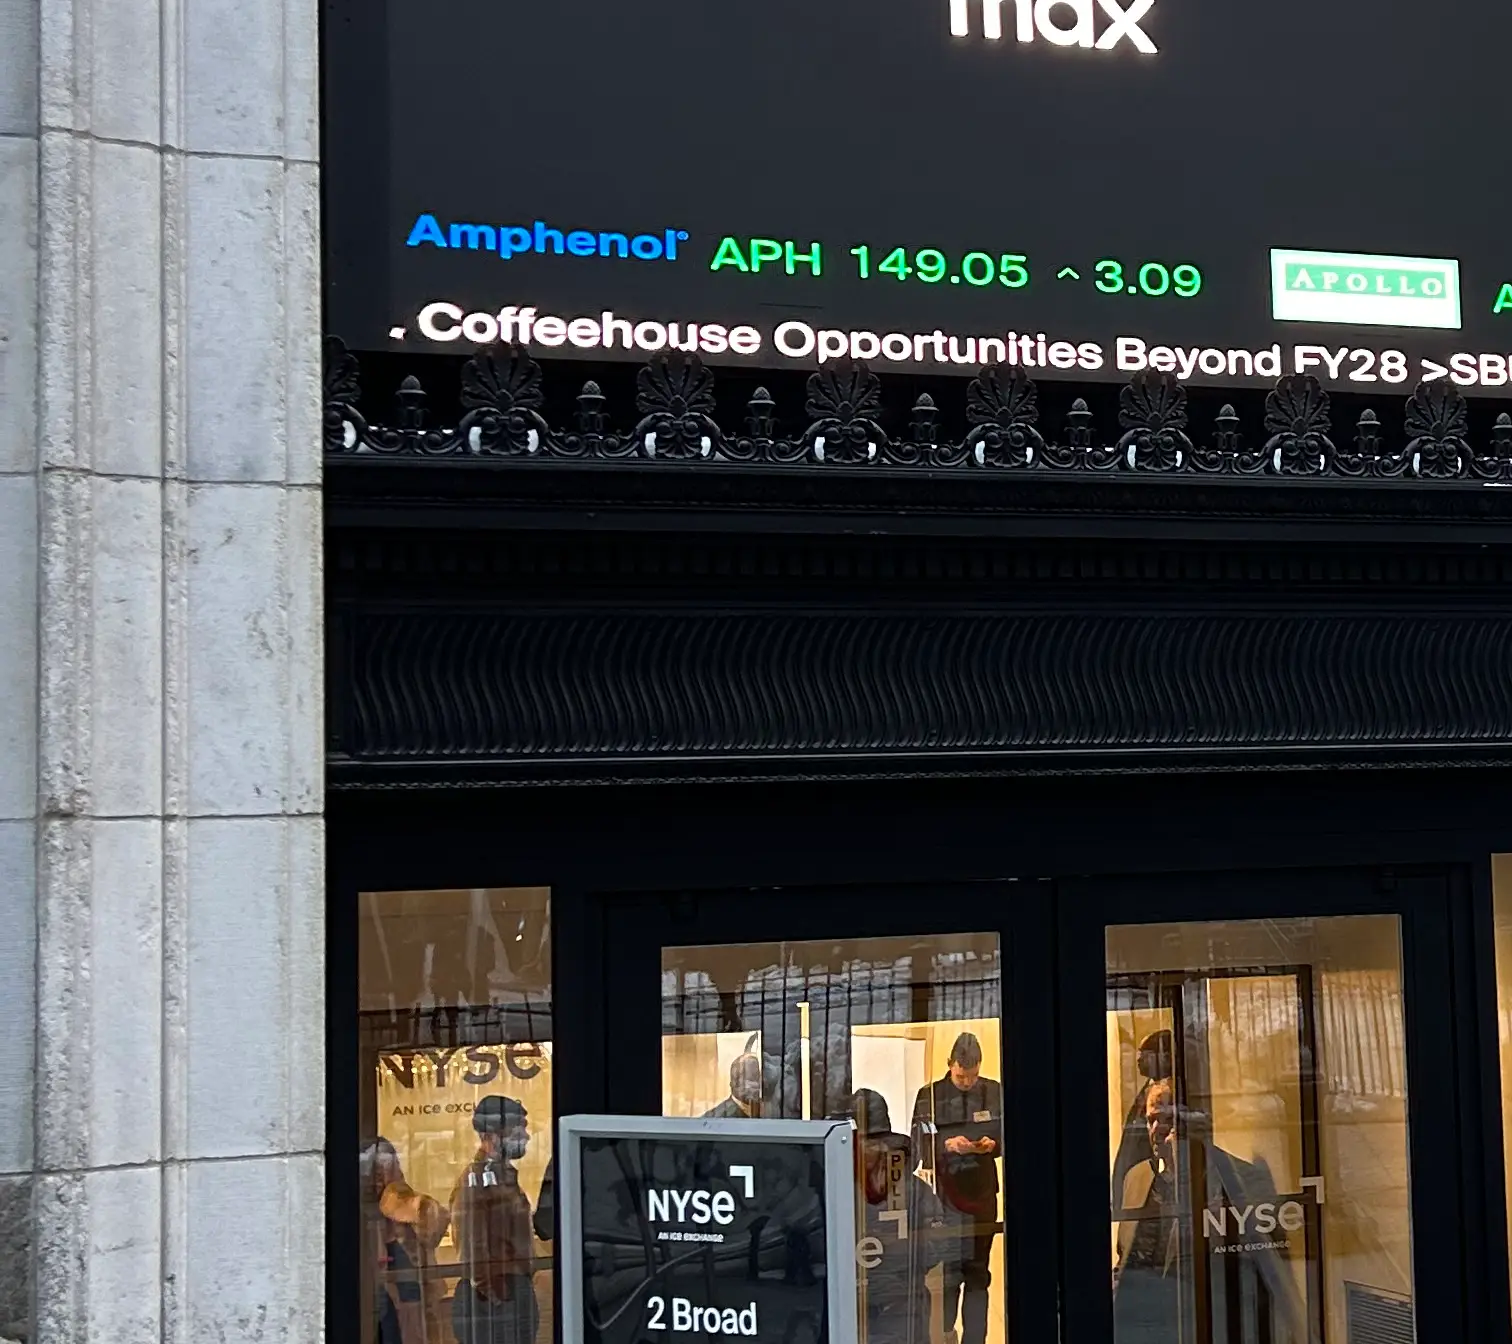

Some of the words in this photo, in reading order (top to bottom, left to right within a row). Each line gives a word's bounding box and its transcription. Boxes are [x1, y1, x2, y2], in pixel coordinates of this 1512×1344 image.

[710, 237, 822, 276] APH
[850, 245, 1030, 288] 149.05
[1291, 267, 1444, 296] APOLLO
[418, 301, 762, 354] Coffeehouse
[773, 319, 1104, 371] Opportunities
[1116, 336, 1282, 380] Beyond
[1294, 344, 1409, 384] FY28
[646, 1295, 667, 1330] 2
[672, 1297, 758, 1336] Broad
